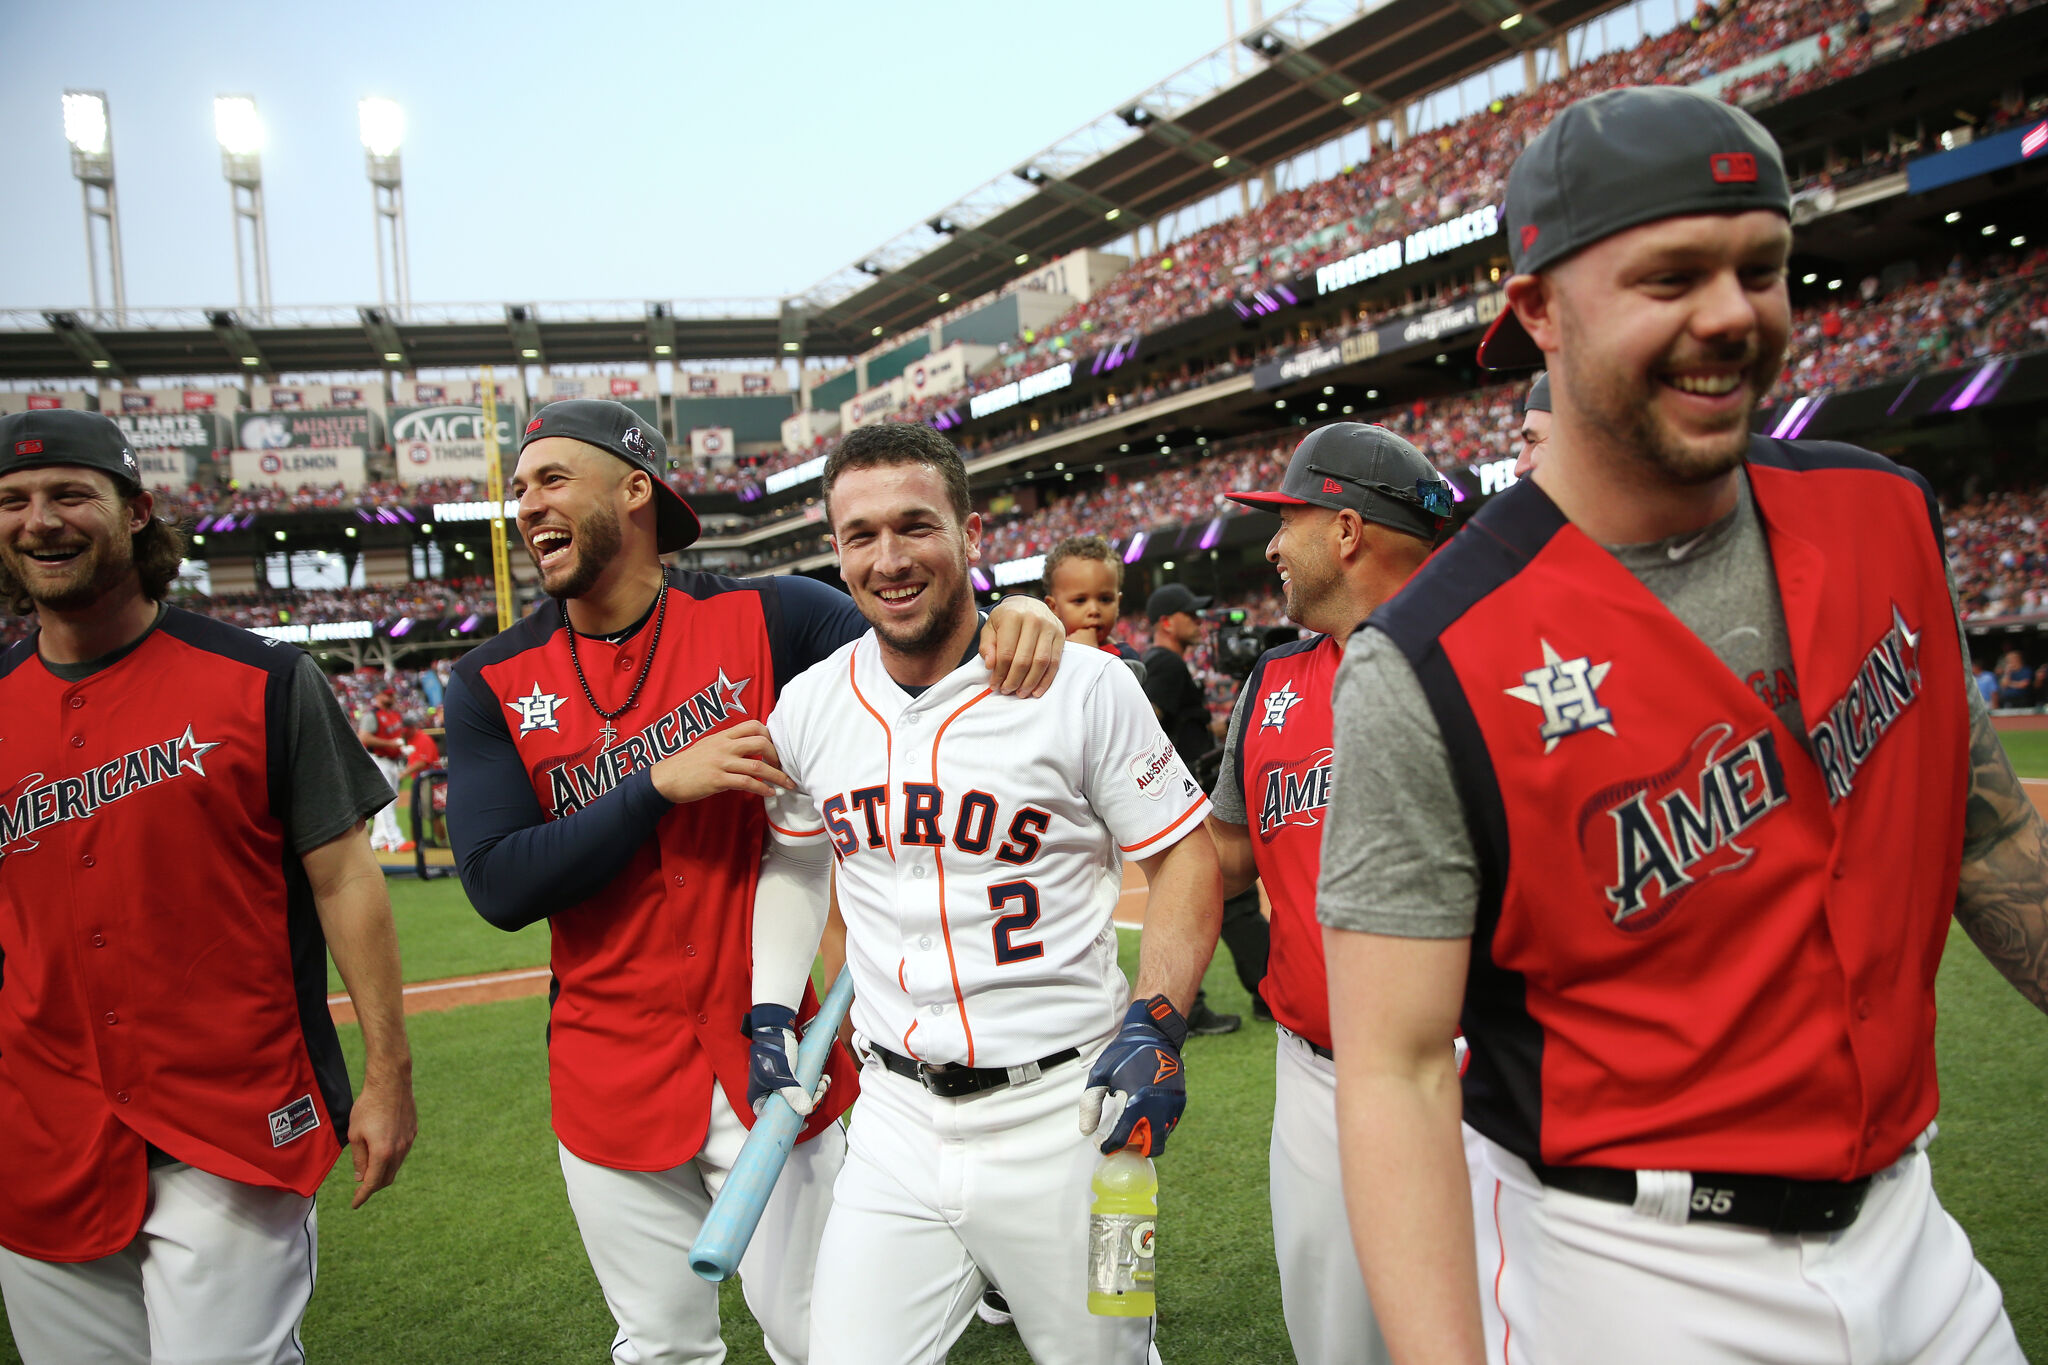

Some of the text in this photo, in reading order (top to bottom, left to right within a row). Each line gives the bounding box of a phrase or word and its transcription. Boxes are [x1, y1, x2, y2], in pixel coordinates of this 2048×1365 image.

[1316, 204, 1498, 295] PEDERSON ADVANCES
[282, 455, 337, 471] LEMON
[292, 415, 367, 434] MINUTE
[546, 681, 729, 820] AMERICAN
[0, 736, 183, 858] MERICAN
[823, 781, 1051, 866] STROS
[987, 879, 1044, 966] 2
[1690, 1186, 1735, 1215] 55
